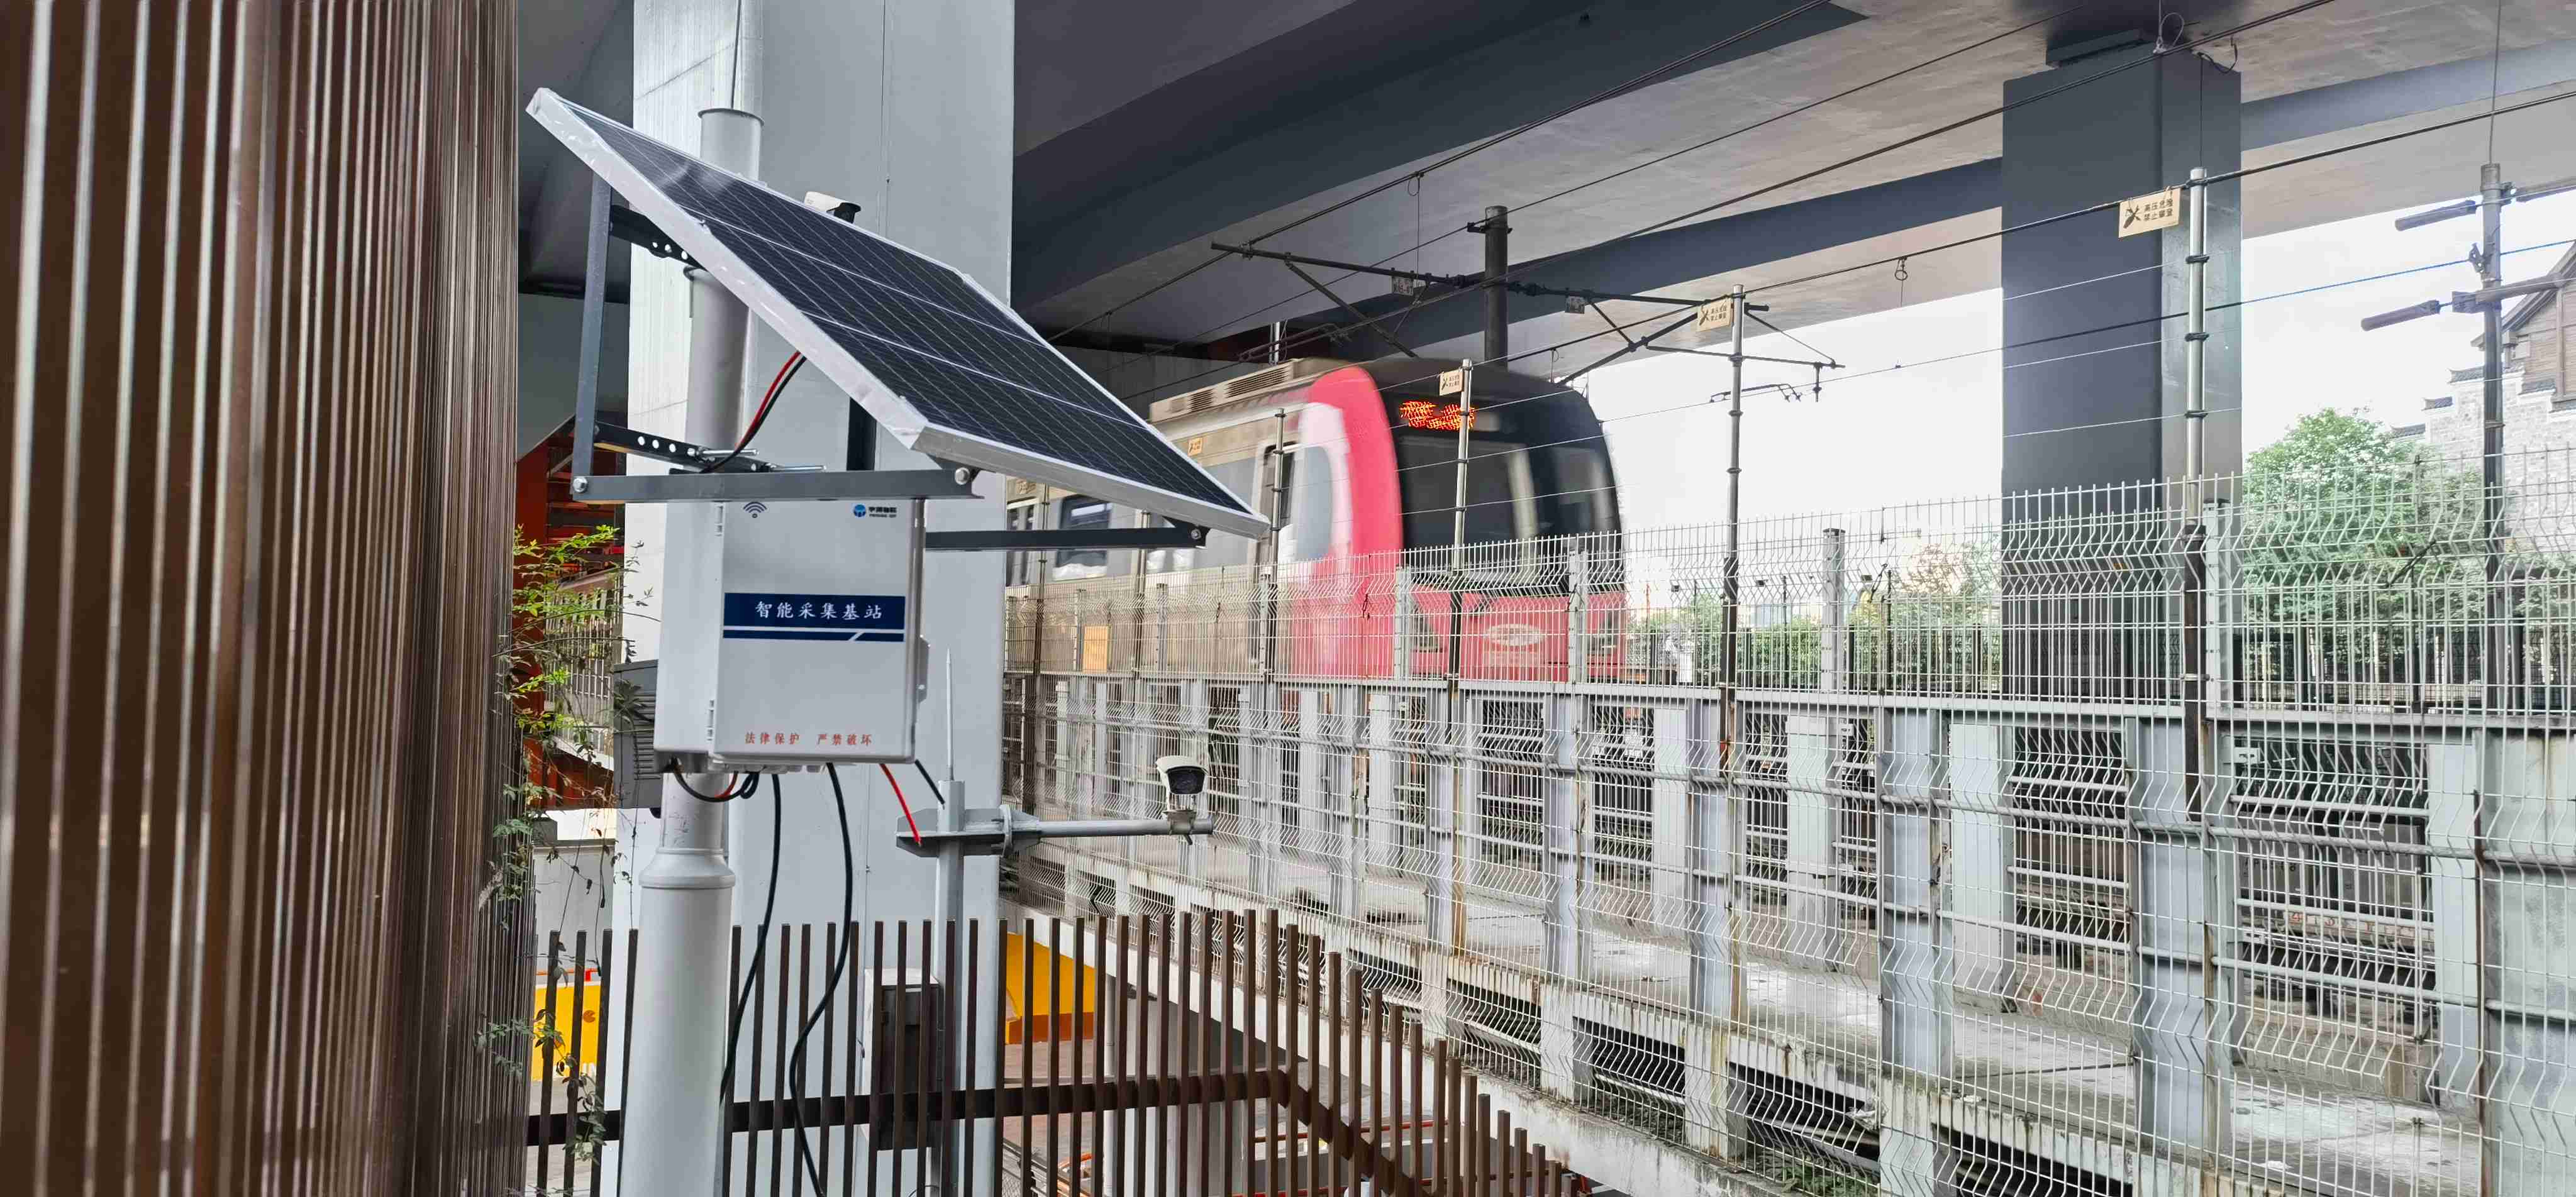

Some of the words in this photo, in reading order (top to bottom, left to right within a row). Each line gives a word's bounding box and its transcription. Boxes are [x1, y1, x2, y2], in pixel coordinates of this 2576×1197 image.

[2143, 199, 2174, 212] 高压危险
[755, 600, 882, 620] 智能采集基站
[744, 732, 800, 745] 法律保护
[817, 732, 873, 746] 严禁破坏
